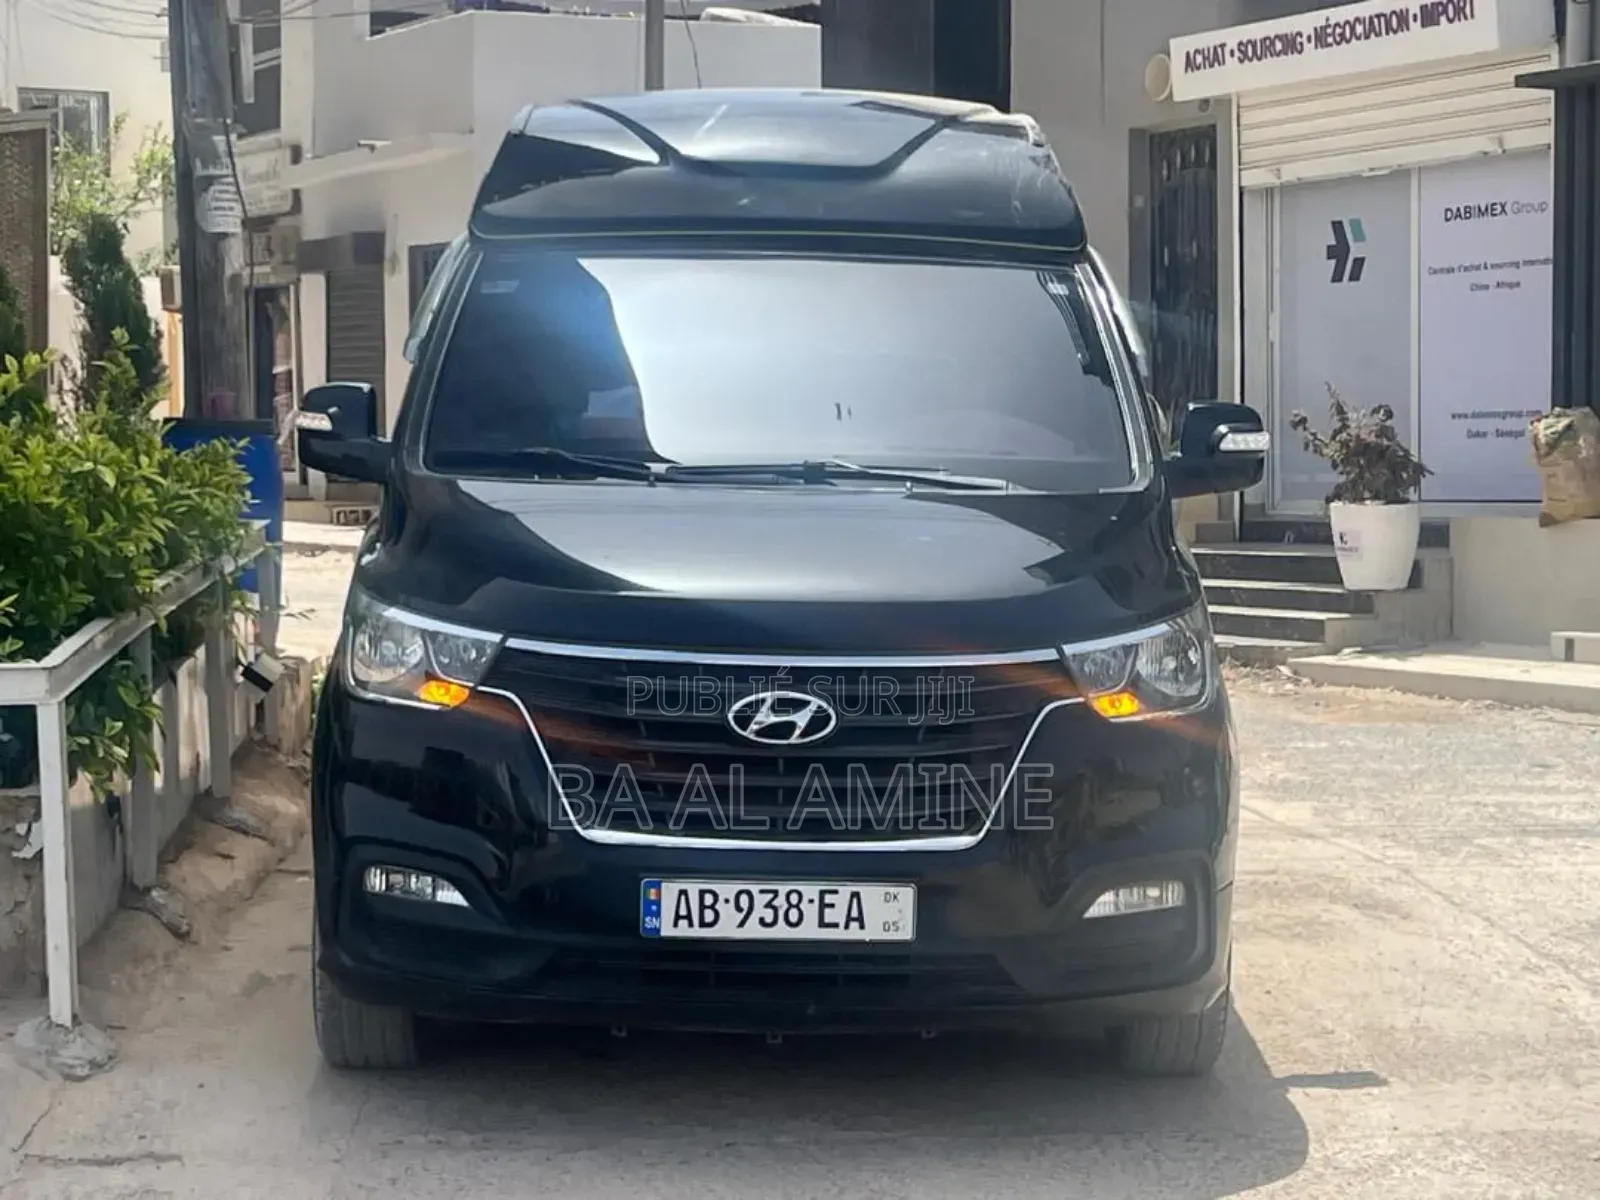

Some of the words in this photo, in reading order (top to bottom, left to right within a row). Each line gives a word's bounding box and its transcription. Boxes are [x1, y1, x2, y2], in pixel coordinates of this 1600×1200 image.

[1184, 42, 1227, 74] ACHAT
[1237, 31, 1304, 64] SOURCING
[1313, 8, 1410, 50] NÉGOCIATION
[1419, 0, 1475, 29] IMPORT
[1444, 201, 1508, 222] DABIMEX
[1511, 200, 1549, 215] Group
[884, 891, 900, 903] DK
[644, 915, 660, 929] SN
